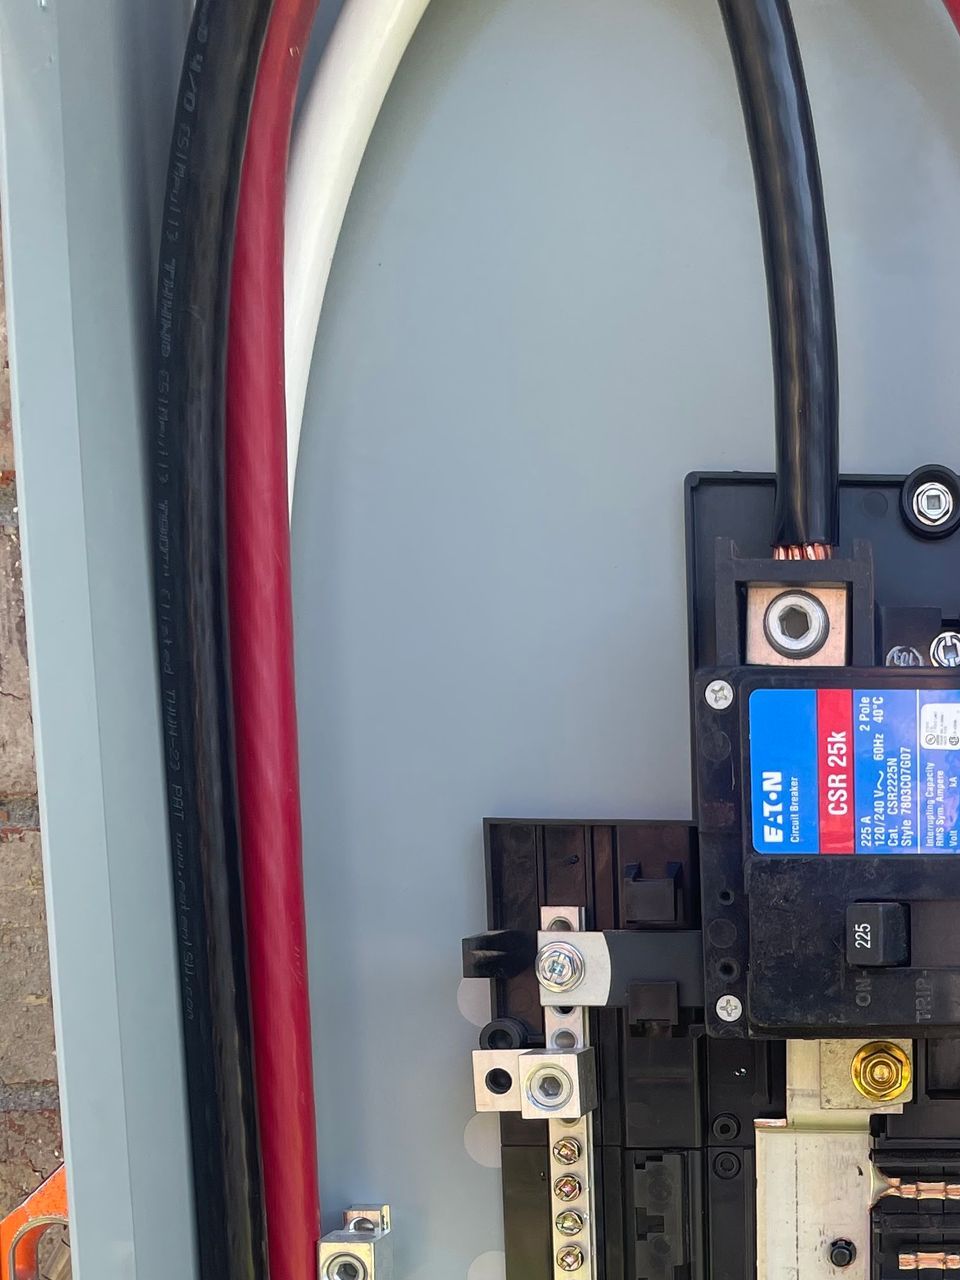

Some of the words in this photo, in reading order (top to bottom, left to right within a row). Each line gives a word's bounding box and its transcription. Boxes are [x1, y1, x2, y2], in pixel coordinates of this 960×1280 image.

[859, 696, 870, 722] Pole
[872, 696, 884, 723] 40°C
[827, 731, 847, 767] 25k
[873, 733, 884, 761] 60Hz
[789, 776, 799, 811] Breaker
[886, 757, 898, 815] CSR2225N
[900, 747, 912, 815] 7803C07G07
[925, 762, 936, 798] Capacity
[935, 770, 946, 802] Ampere
[949, 776, 957, 788] kA
[827, 774, 848, 815] CSR
[790, 813, 800, 843] Circuit
[860, 815, 871, 824] A
[874, 801, 885, 847] 120/240
[926, 799, 936, 847] Interrupting
[936, 803, 946, 826] Sym.
[861, 826, 872, 847] 225
[887, 825, 899, 847] Cat.
[900, 819, 914, 847] Style
[936, 827, 944, 847] RMS
[949, 830, 958, 847] Volt
[855, 923, 871, 949] 225
[855, 978, 872, 1007] ON
[915, 977, 932, 1024] TRIP
